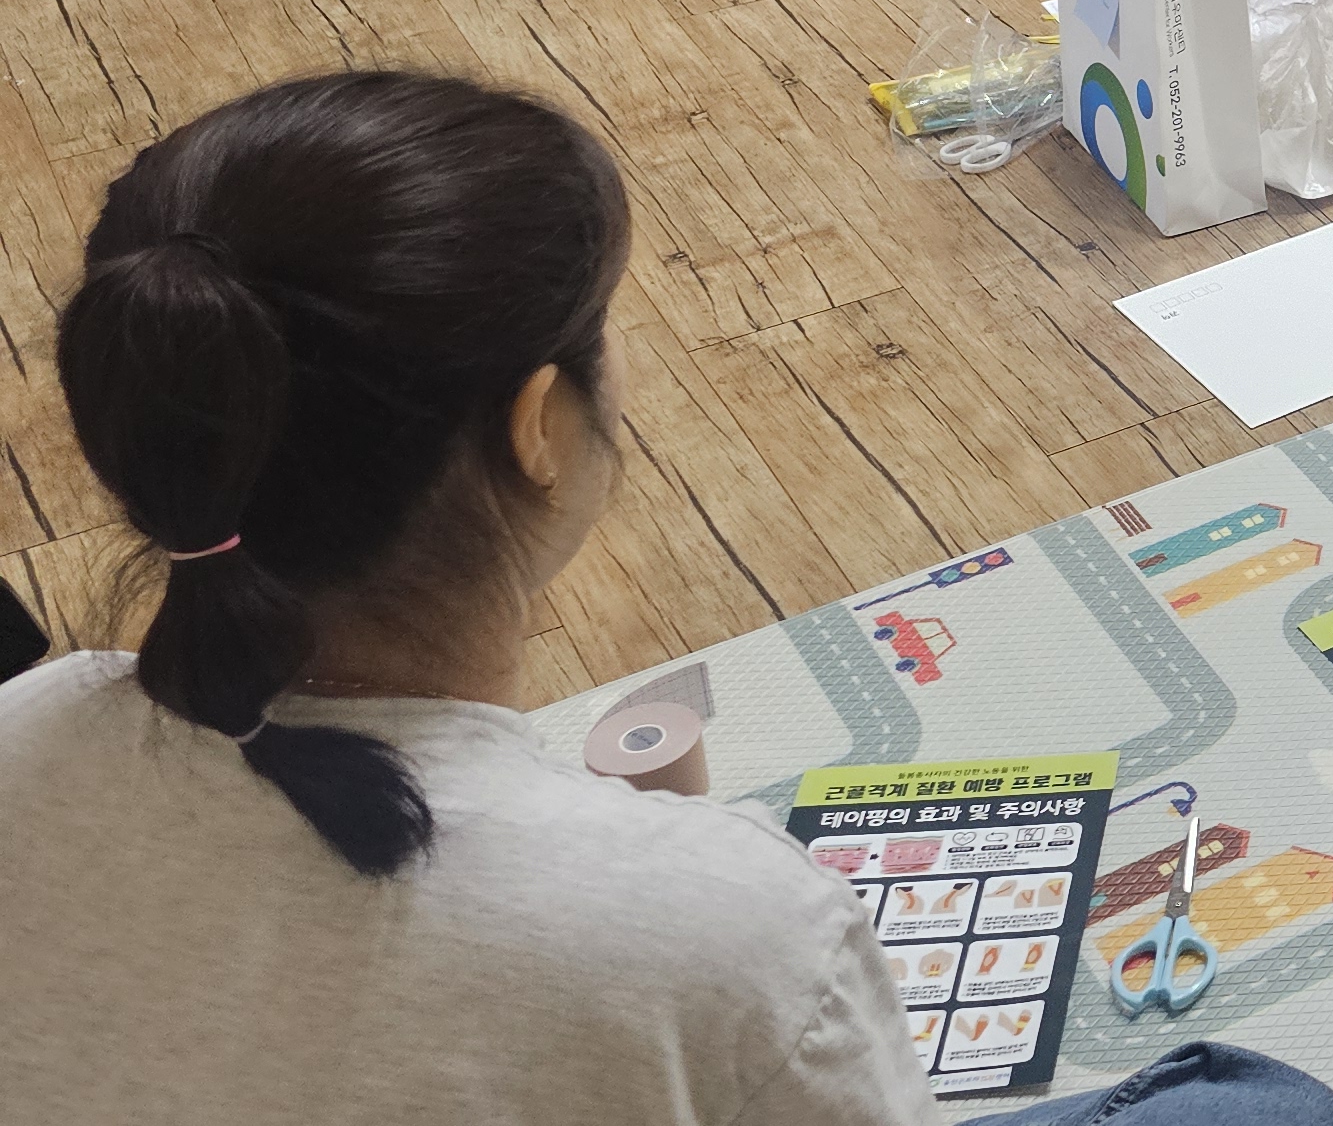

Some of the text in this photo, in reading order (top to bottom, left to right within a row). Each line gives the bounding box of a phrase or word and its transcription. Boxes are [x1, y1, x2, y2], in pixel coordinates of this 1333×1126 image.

[1169, 80, 1187, 167] 052-201-9963
[825, 772, 1093, 800] 근골격계 질환 예방 프로그램
[820, 797, 1085, 829] 테이핑의 효과 및 주의사항
